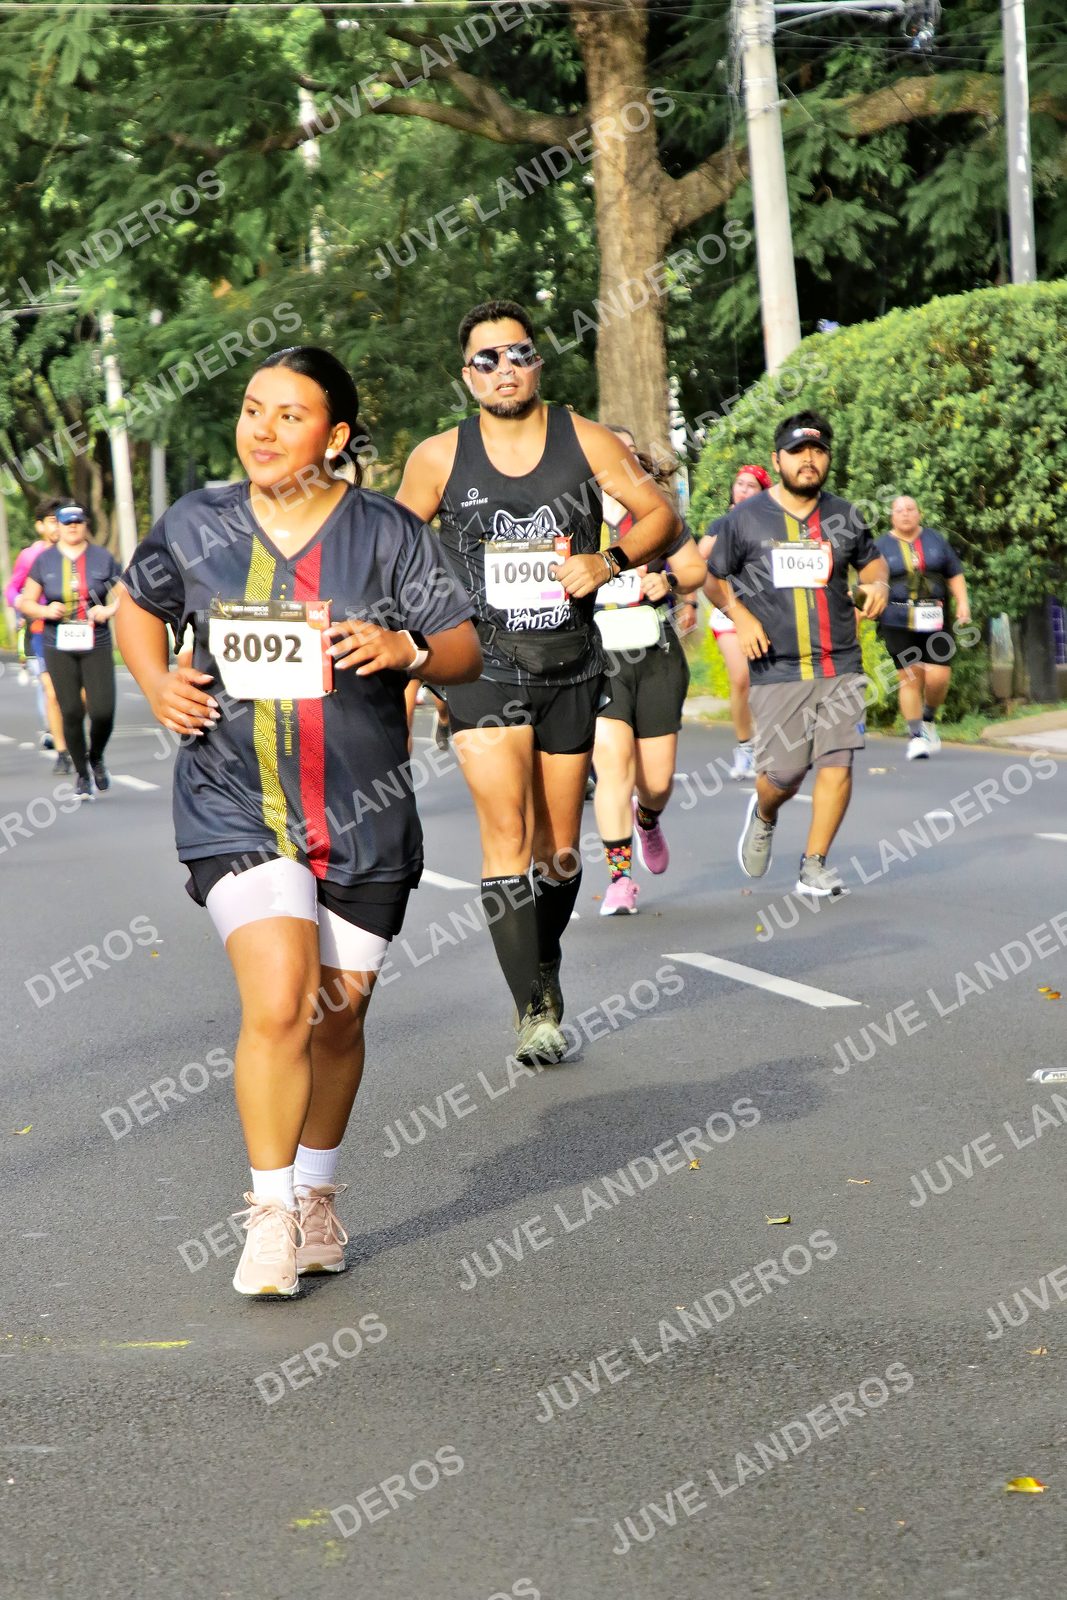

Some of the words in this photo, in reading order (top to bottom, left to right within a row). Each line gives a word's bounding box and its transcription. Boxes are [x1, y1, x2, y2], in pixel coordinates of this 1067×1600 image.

[460, 497, 488, 508] TOPTIME
[779, 556, 824, 570] 10645
[223, 632, 302, 663] 8092
